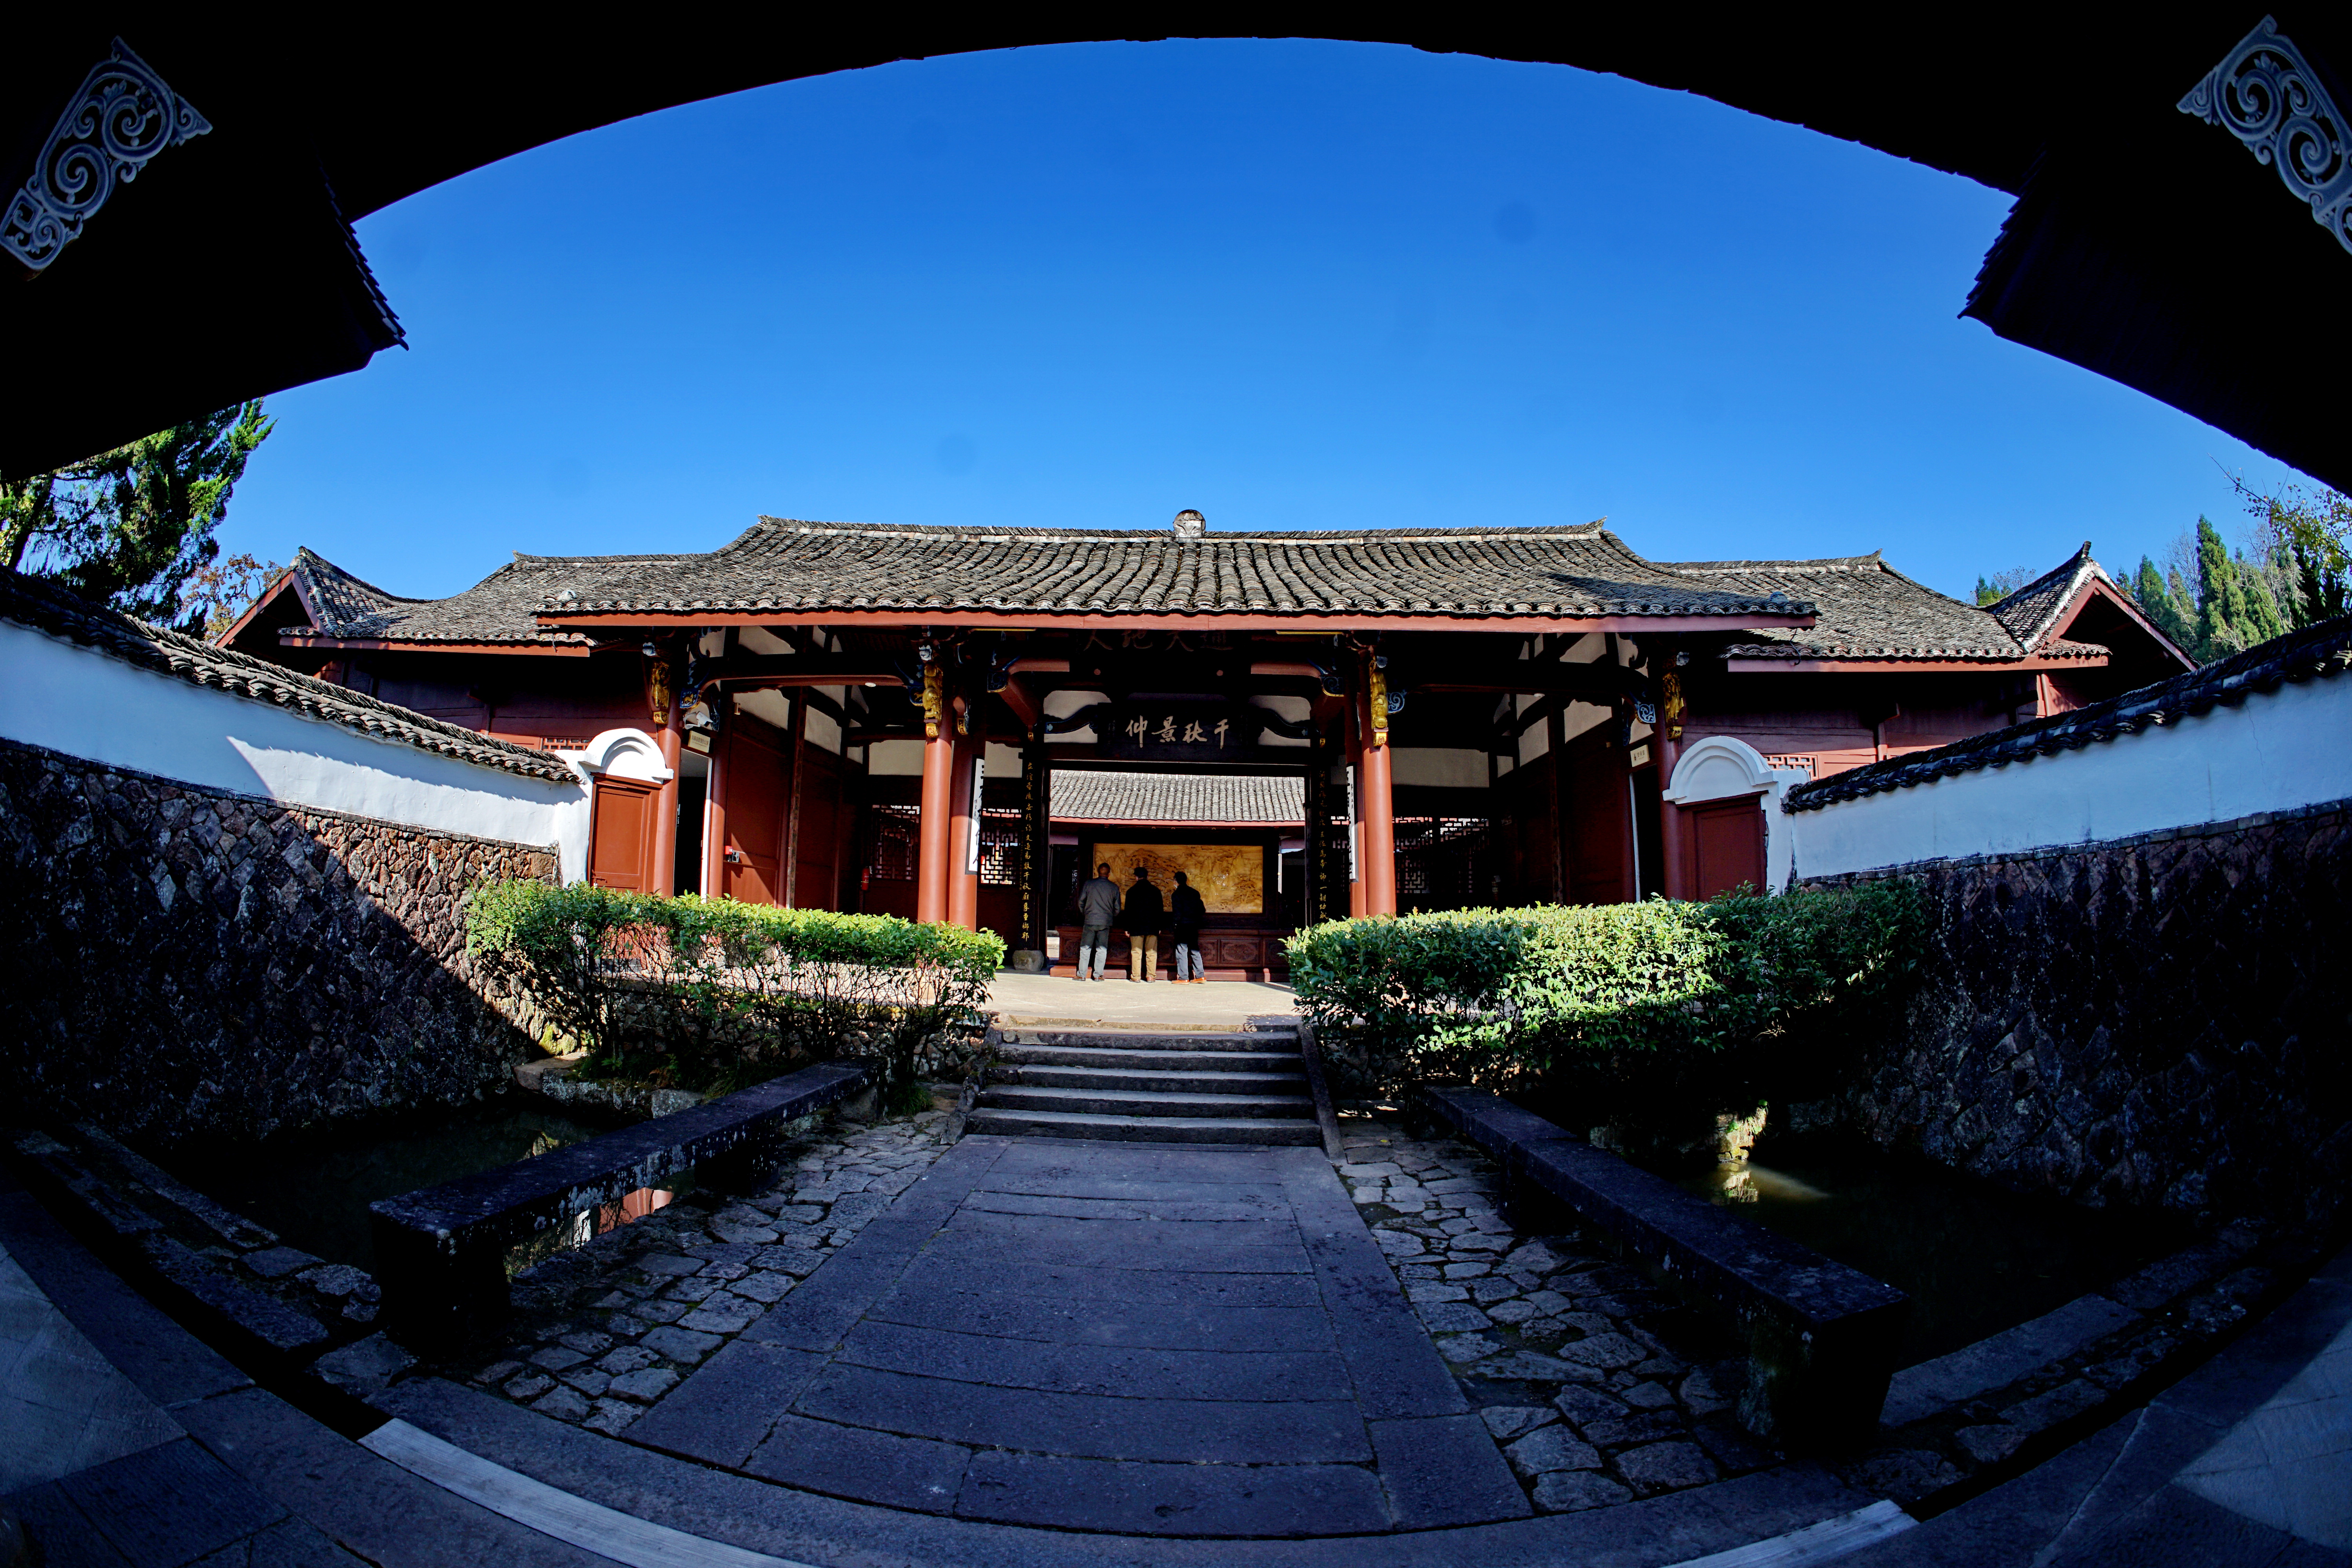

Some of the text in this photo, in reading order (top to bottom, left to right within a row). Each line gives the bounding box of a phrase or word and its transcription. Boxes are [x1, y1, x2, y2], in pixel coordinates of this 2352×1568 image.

[1082, 629, 1235, 652] 通天地人
[1125, 715, 1230, 750] 千秋景仰
